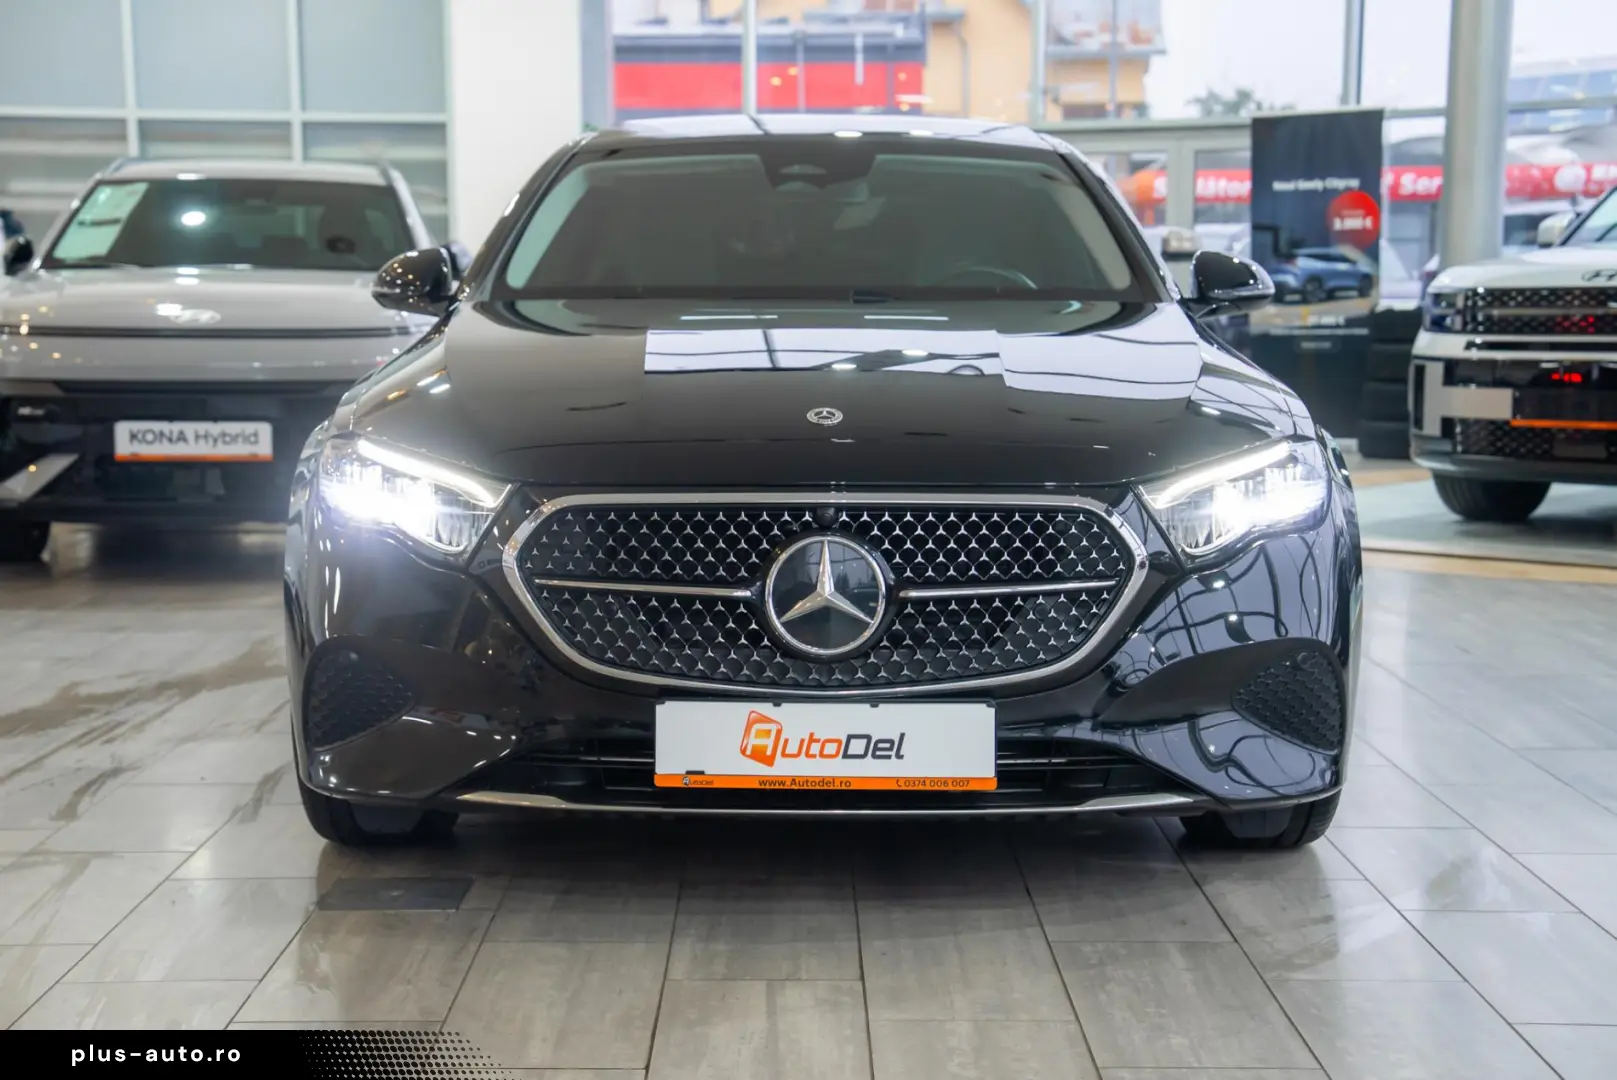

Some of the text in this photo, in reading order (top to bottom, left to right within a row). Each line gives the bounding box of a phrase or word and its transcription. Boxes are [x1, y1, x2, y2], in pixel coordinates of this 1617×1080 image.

[129, 428, 260, 449] KONA Hybrid
[741, 715, 905, 763] AutoDel
[758, 777, 852, 789] www.Autodel.ro
[904, 778, 970, 789] 0374 006 007
